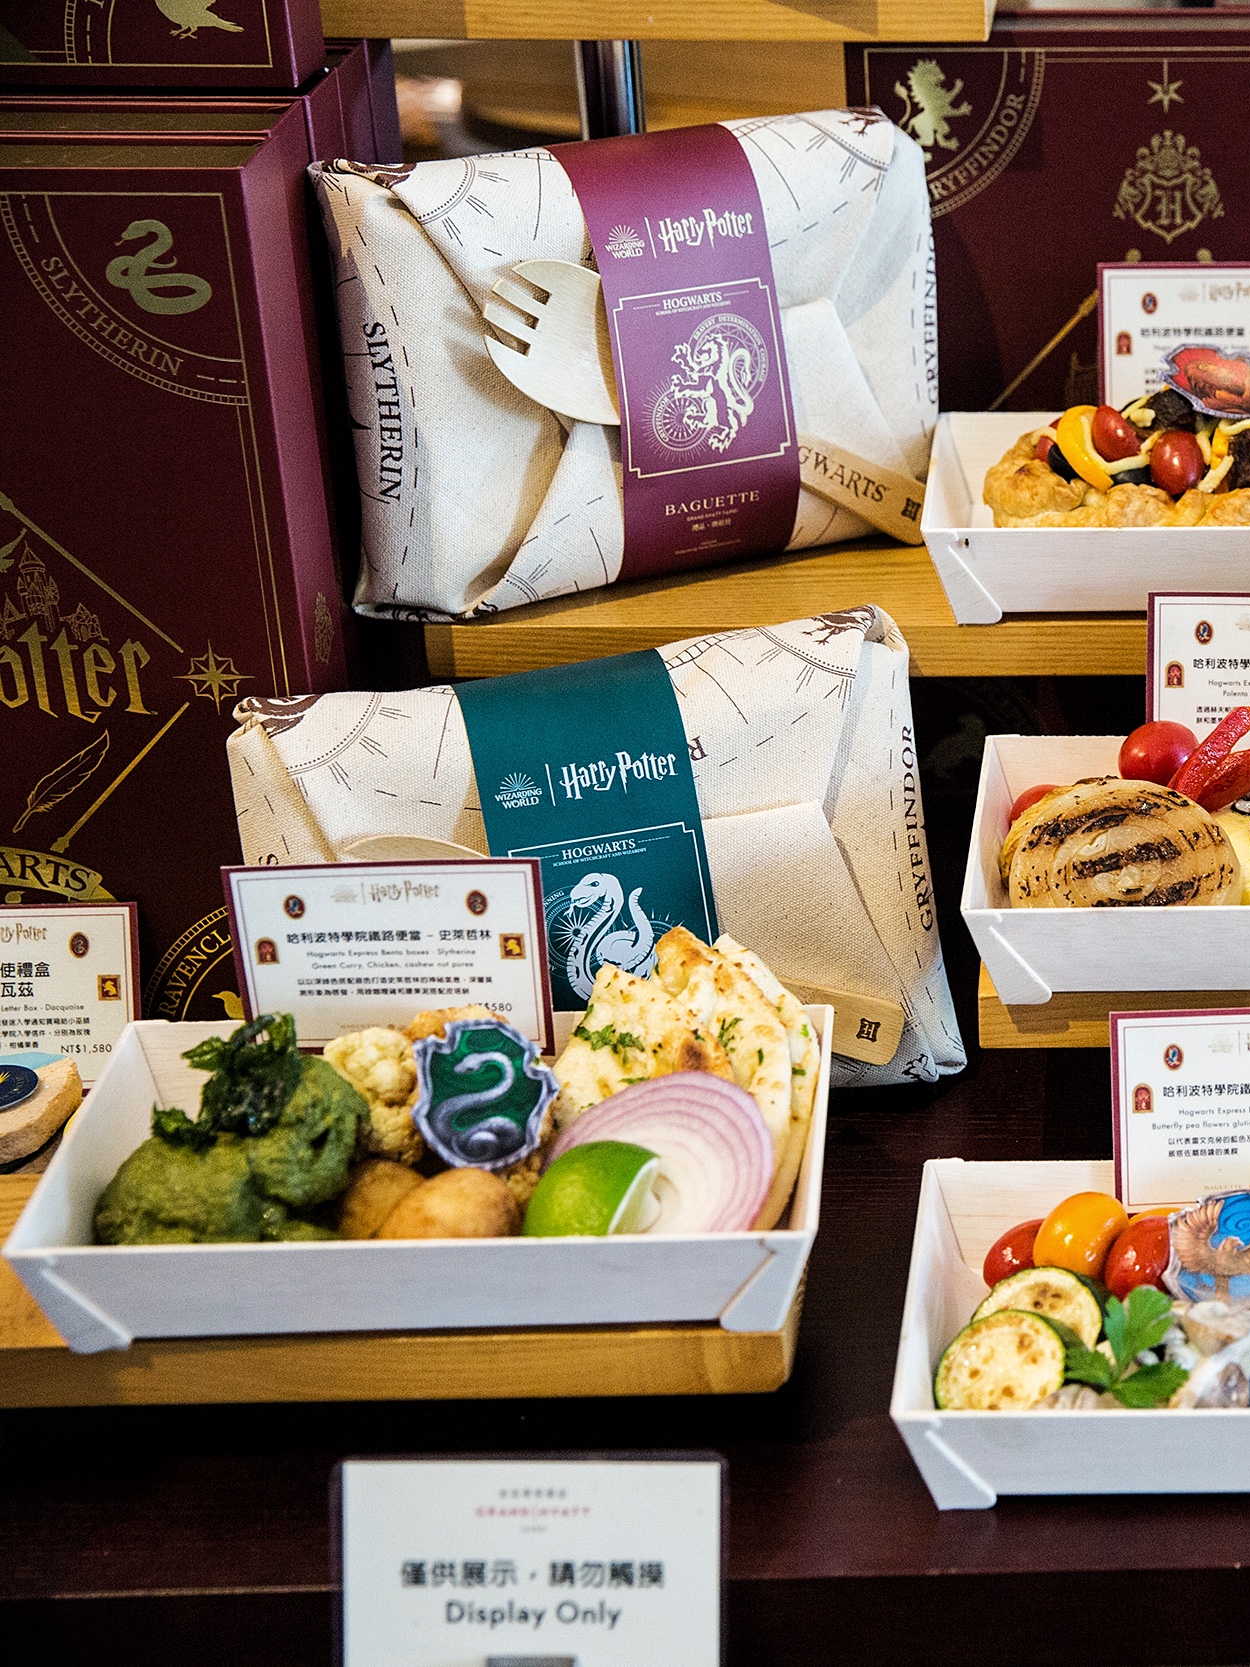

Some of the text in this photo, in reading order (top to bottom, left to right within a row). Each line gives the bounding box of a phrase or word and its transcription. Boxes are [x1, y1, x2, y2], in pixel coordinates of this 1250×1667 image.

[927, 91, 1027, 201] RYFFINDOR
[658, 208, 754, 253] Harry Potter
[605, 239, 645, 252] WIZARDING
[611, 247, 643, 259] WORLD
[662, 292, 723, 310] HOGWARTS
[40, 257, 184, 377] SLYTHERIN
[362, 320, 402, 501] SLYTHERIN
[665, 490, 760, 516] BAGUETTE
[1208, 679, 1241, 687] Hogwarts
[559, 750, 679, 800] Harry Potter
[494, 787, 543, 802] WIZARDING
[502, 796, 540, 810] WORLD
[901, 725, 934, 932] GRYFFINDOR
[561, 838, 636, 861] HOGWARTS
[552, 859, 572, 867] SCHOOL
[579, 853, 611, 863] WITCHCRAFT
[15, 922, 47, 945] Potter
[287, 929, 492, 944] 哈利波特學院鐵路便當 史萊哲林
[306, 950, 346, 959] Hogwarts
[348, 949, 379, 958] Express
[405, 948, 430, 956] boxes
[311, 962, 337, 970] Green
[451, 961, 474, 969] puree
[60, 1044, 113, 1054] NT$1,580
[1178, 1107, 1215, 1117] Hogwarts
[1217, 1106, 1246, 1115] Express
[1151, 1121, 1183, 1131] Butterfly
[1185, 1123, 1200, 1131] pea
[1202, 1120, 1230, 1129] flowers
[401, 1559, 666, 1590] 僅供展示，請勿觸摸
[446, 1600, 622, 1630] Display Only
